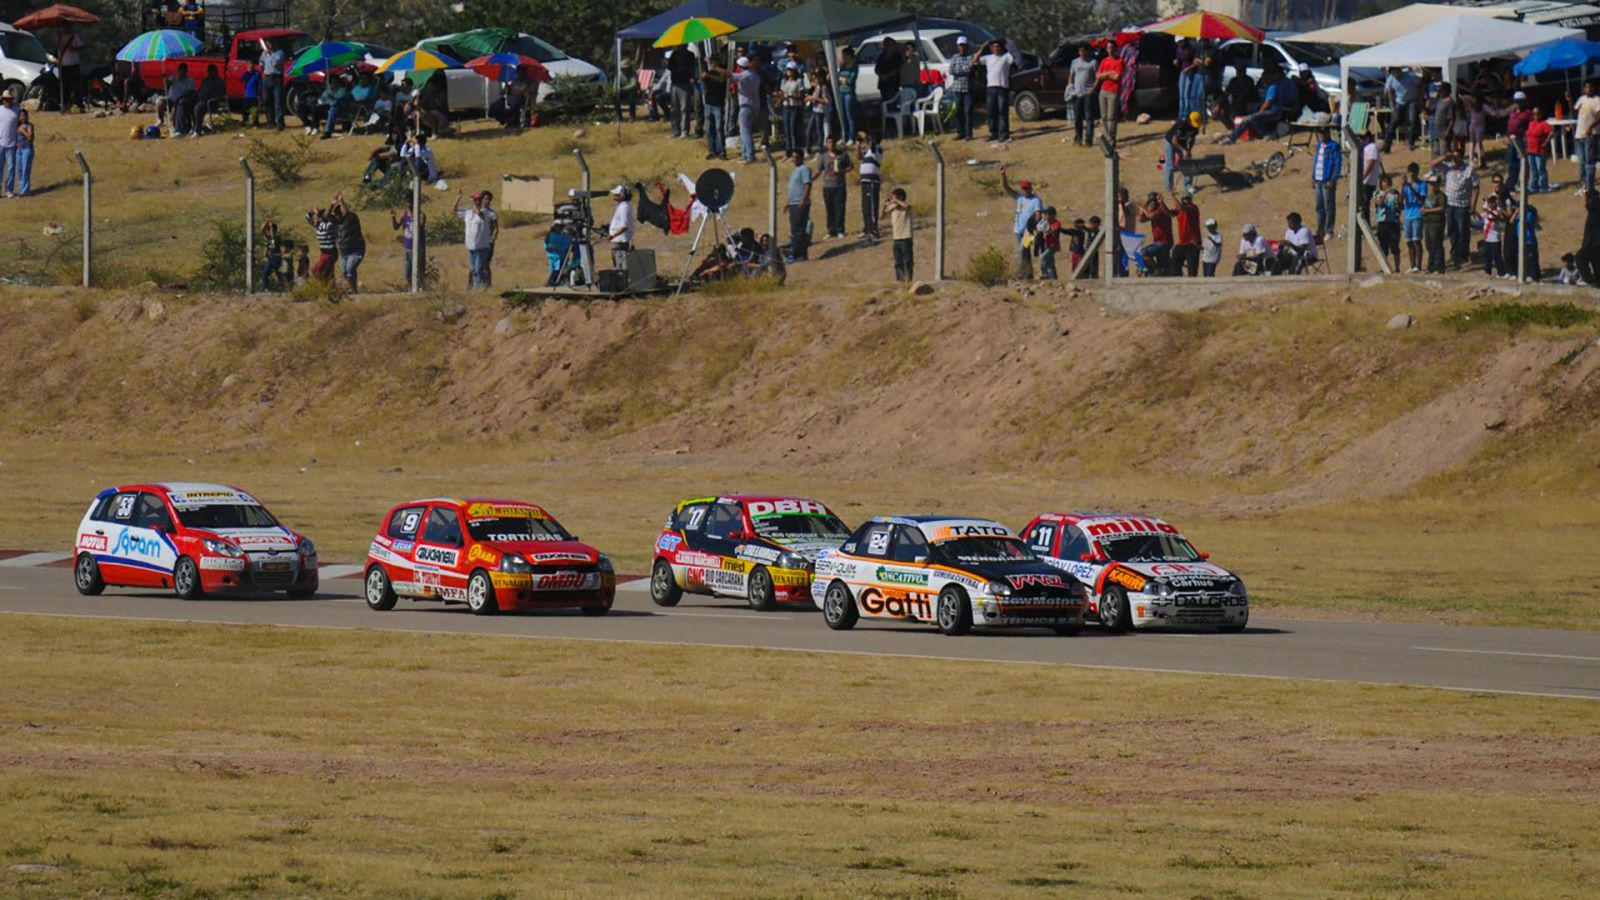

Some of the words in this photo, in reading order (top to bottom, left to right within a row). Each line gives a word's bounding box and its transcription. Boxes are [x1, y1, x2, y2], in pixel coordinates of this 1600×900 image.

[118, 497, 135, 516] 53
[748, 500, 827, 515] DBH
[403, 514, 419, 531] 9
[689, 508, 706, 526] 17
[949, 525, 1008, 536] TATO
[1038, 527, 1053, 546] 11
[81, 535, 106, 551] MOTUL
[871, 534, 887, 550] 24
[724, 559, 744, 572] med
[861, 588, 934, 618] Gatti
